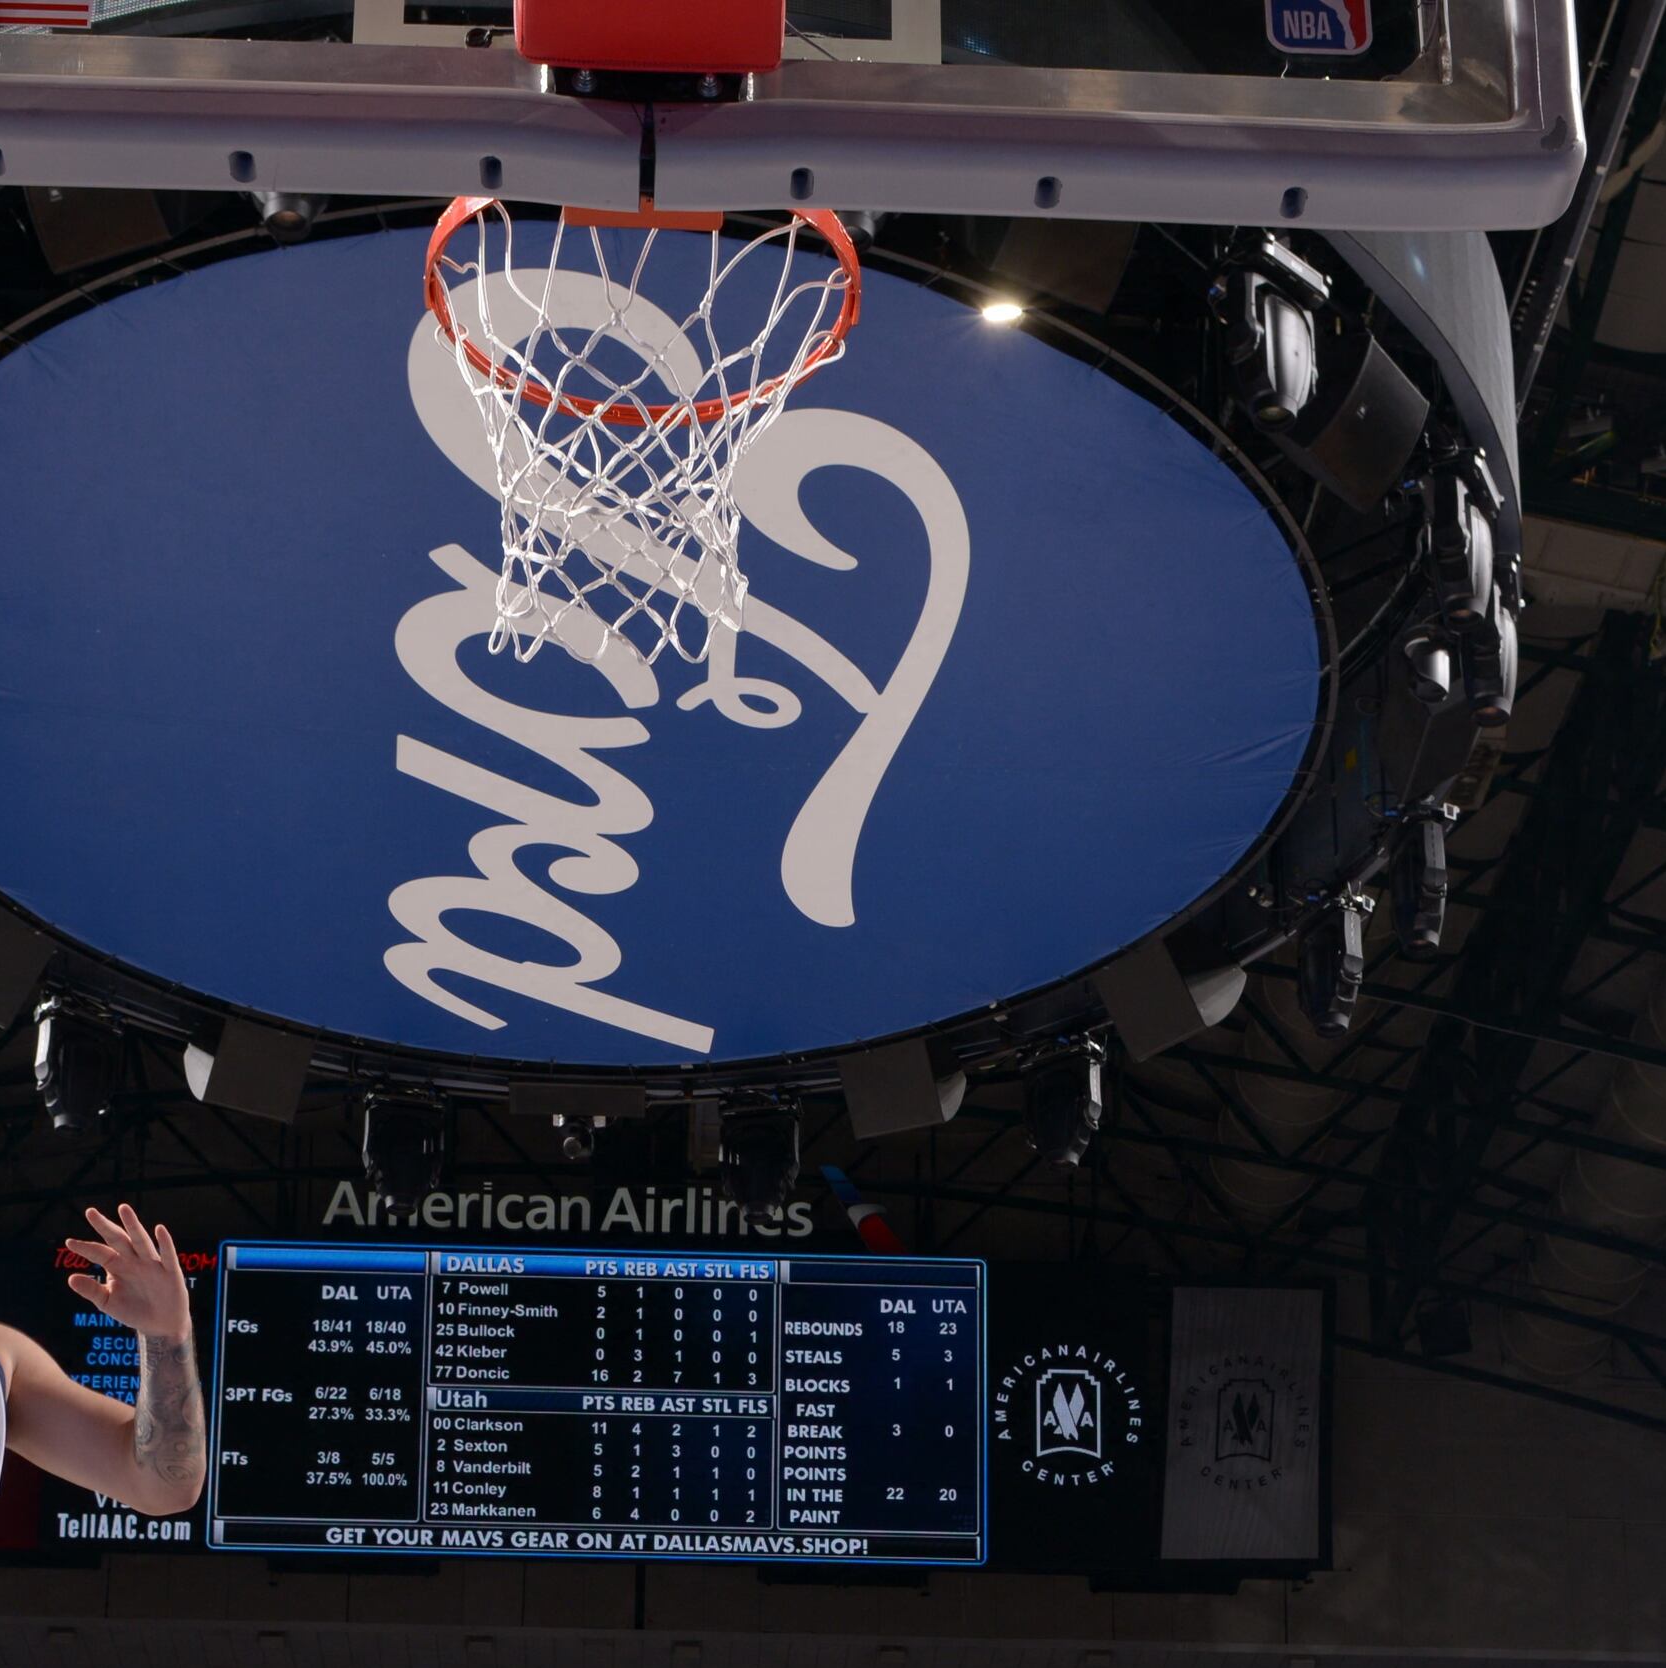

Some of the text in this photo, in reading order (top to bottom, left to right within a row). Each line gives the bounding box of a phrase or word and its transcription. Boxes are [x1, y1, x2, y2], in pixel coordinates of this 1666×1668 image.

[1283, 10, 1332, 40] NBA
[382, 268, 971, 1055] Ford
[447, 1255, 769, 1279] DALLAS PTS REB AST STL FLS
[322, 1285, 412, 1300] DAL UTA
[459, 1282, 508, 1295] Powell
[457, 1303, 558, 1319] Finney-Smith
[880, 1299, 967, 1314] DAL UTA
[227, 1319, 407, 1334] FGs 18/41 18/40
[457, 1323, 515, 1337] Bullock
[785, 1321, 957, 1337] REBOUNDS 18 23
[308, 1339, 412, 1354] 43.9% 45.0%
[456, 1345, 508, 1359] Kleber
[785, 1350, 843, 1364] STEALS
[456, 1365, 510, 1379] Doncic
[785, 1378, 850, 1393] BLOCKS
[225, 1386, 401, 1402] 3PT FGs 6/22 6/18
[436, 1389, 768, 1414] Utah PTS REB AST STL FLS
[308, 1406, 410, 1422] 27.3% 33.3%
[796, 1403, 835, 1417] FAST
[454, 1417, 524, 1432] Clarkson
[787, 1424, 842, 1439] BREAK
[454, 1439, 507, 1452] Sexton
[784, 1446, 847, 1460] POINTS
[221, 1451, 395, 1466] FTs 3/8 5/5
[453, 1460, 532, 1474] Vanderbilt
[784, 1466, 847, 1481] POINTS
[1021, 1459, 1111, 1487] CENTER
[307, 1471, 407, 1487] 37.5% 100.0%
[452, 1482, 507, 1498] Conley
[787, 1487, 957, 1503] IN THE 22 20
[452, 1503, 537, 1518] Markkanen
[790, 1509, 840, 1524] PAINT
[57, 1512, 191, 1541] TellAAC.com
[326, 1527, 868, 1555] GET YOUR MAVS GEAR ON AT DALLASMAVS.SHOP!
